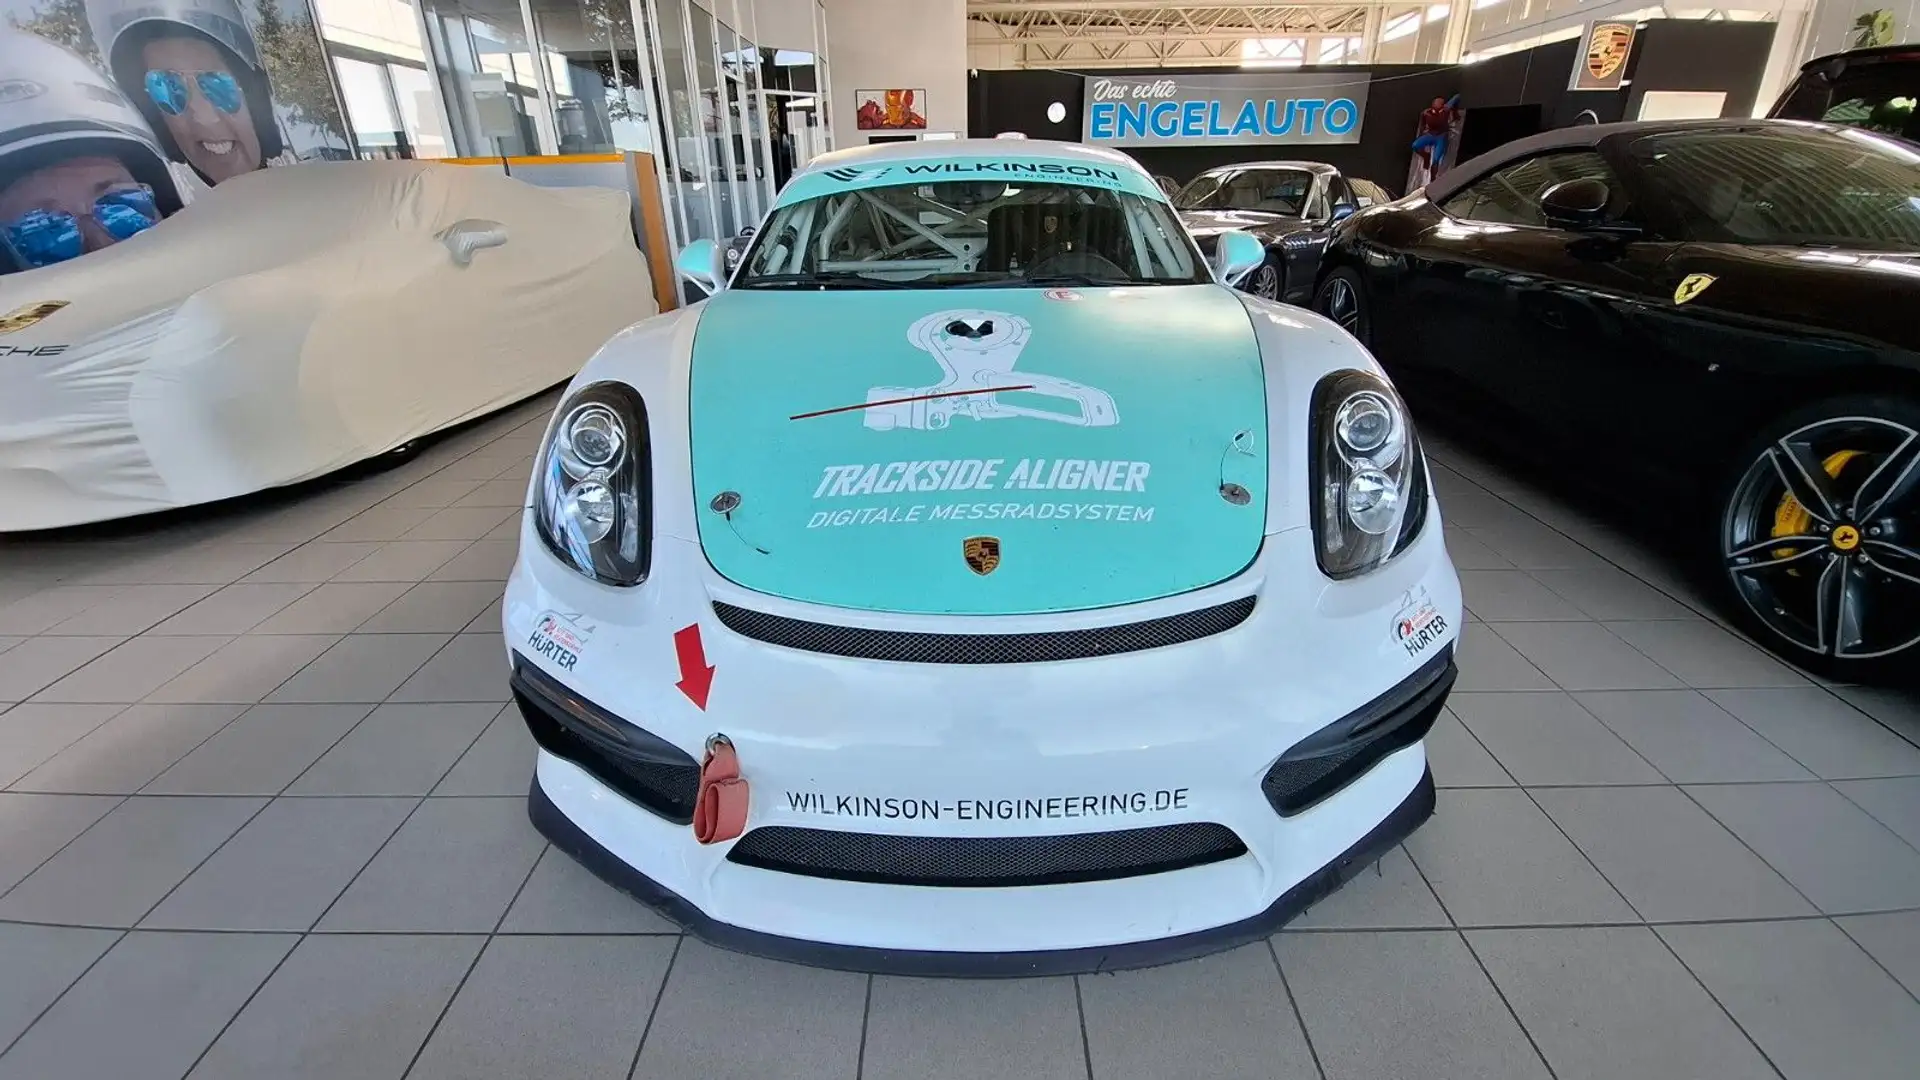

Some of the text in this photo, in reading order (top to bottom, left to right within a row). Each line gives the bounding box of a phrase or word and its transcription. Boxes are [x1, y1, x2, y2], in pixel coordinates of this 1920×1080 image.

[1093, 79, 1178, 101] Das echte
[1090, 98, 1358, 140] ENGELAUTO
[904, 162, 1119, 181] WILKINSON
[1014, 173, 1122, 187] ENGINEERING
[812, 458, 1151, 499] TRACKSIDE ALIGNER
[806, 502, 1155, 529] DIGITALE MESSRADSYSTEM
[527, 630, 578, 673] HÜRTER
[1403, 615, 1448, 657] HÜRTER
[785, 788, 1190, 820] WILKINSON-ENGINEERING.DE
